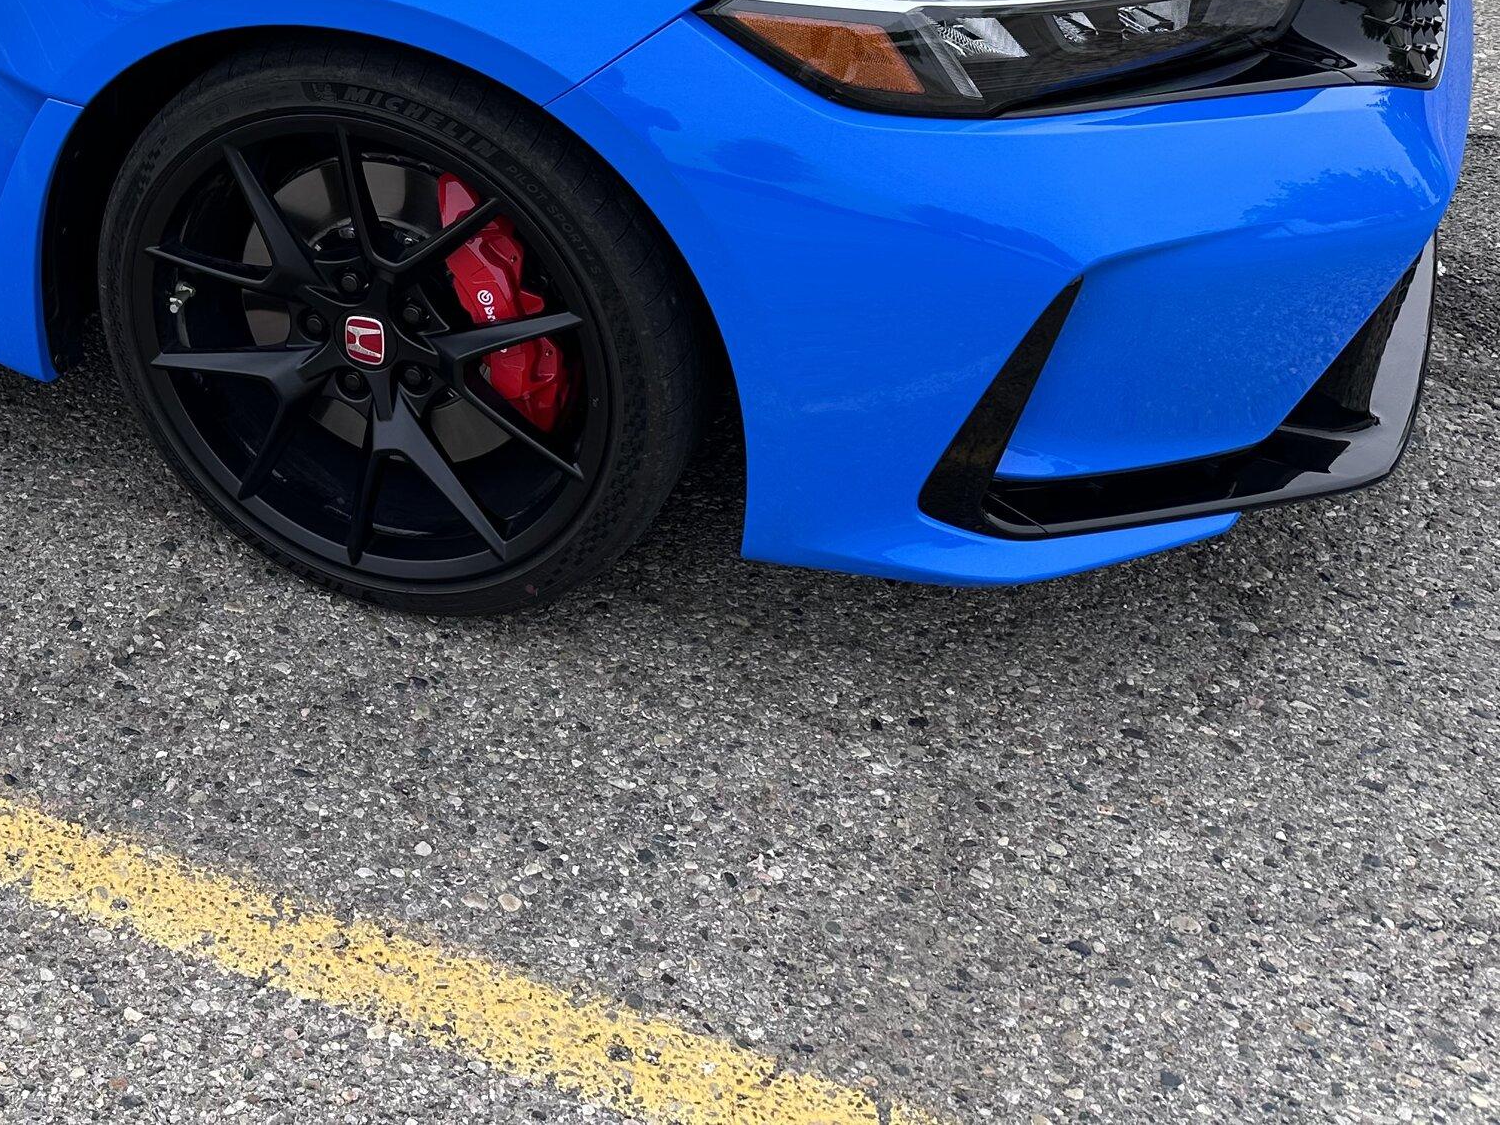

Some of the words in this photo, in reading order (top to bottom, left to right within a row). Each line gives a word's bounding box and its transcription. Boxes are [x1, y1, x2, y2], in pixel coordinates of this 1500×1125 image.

[342, 85, 500, 155] MICHELIN
[505, 164, 548, 200] PILOT
[546, 205, 590, 253] SPORT
